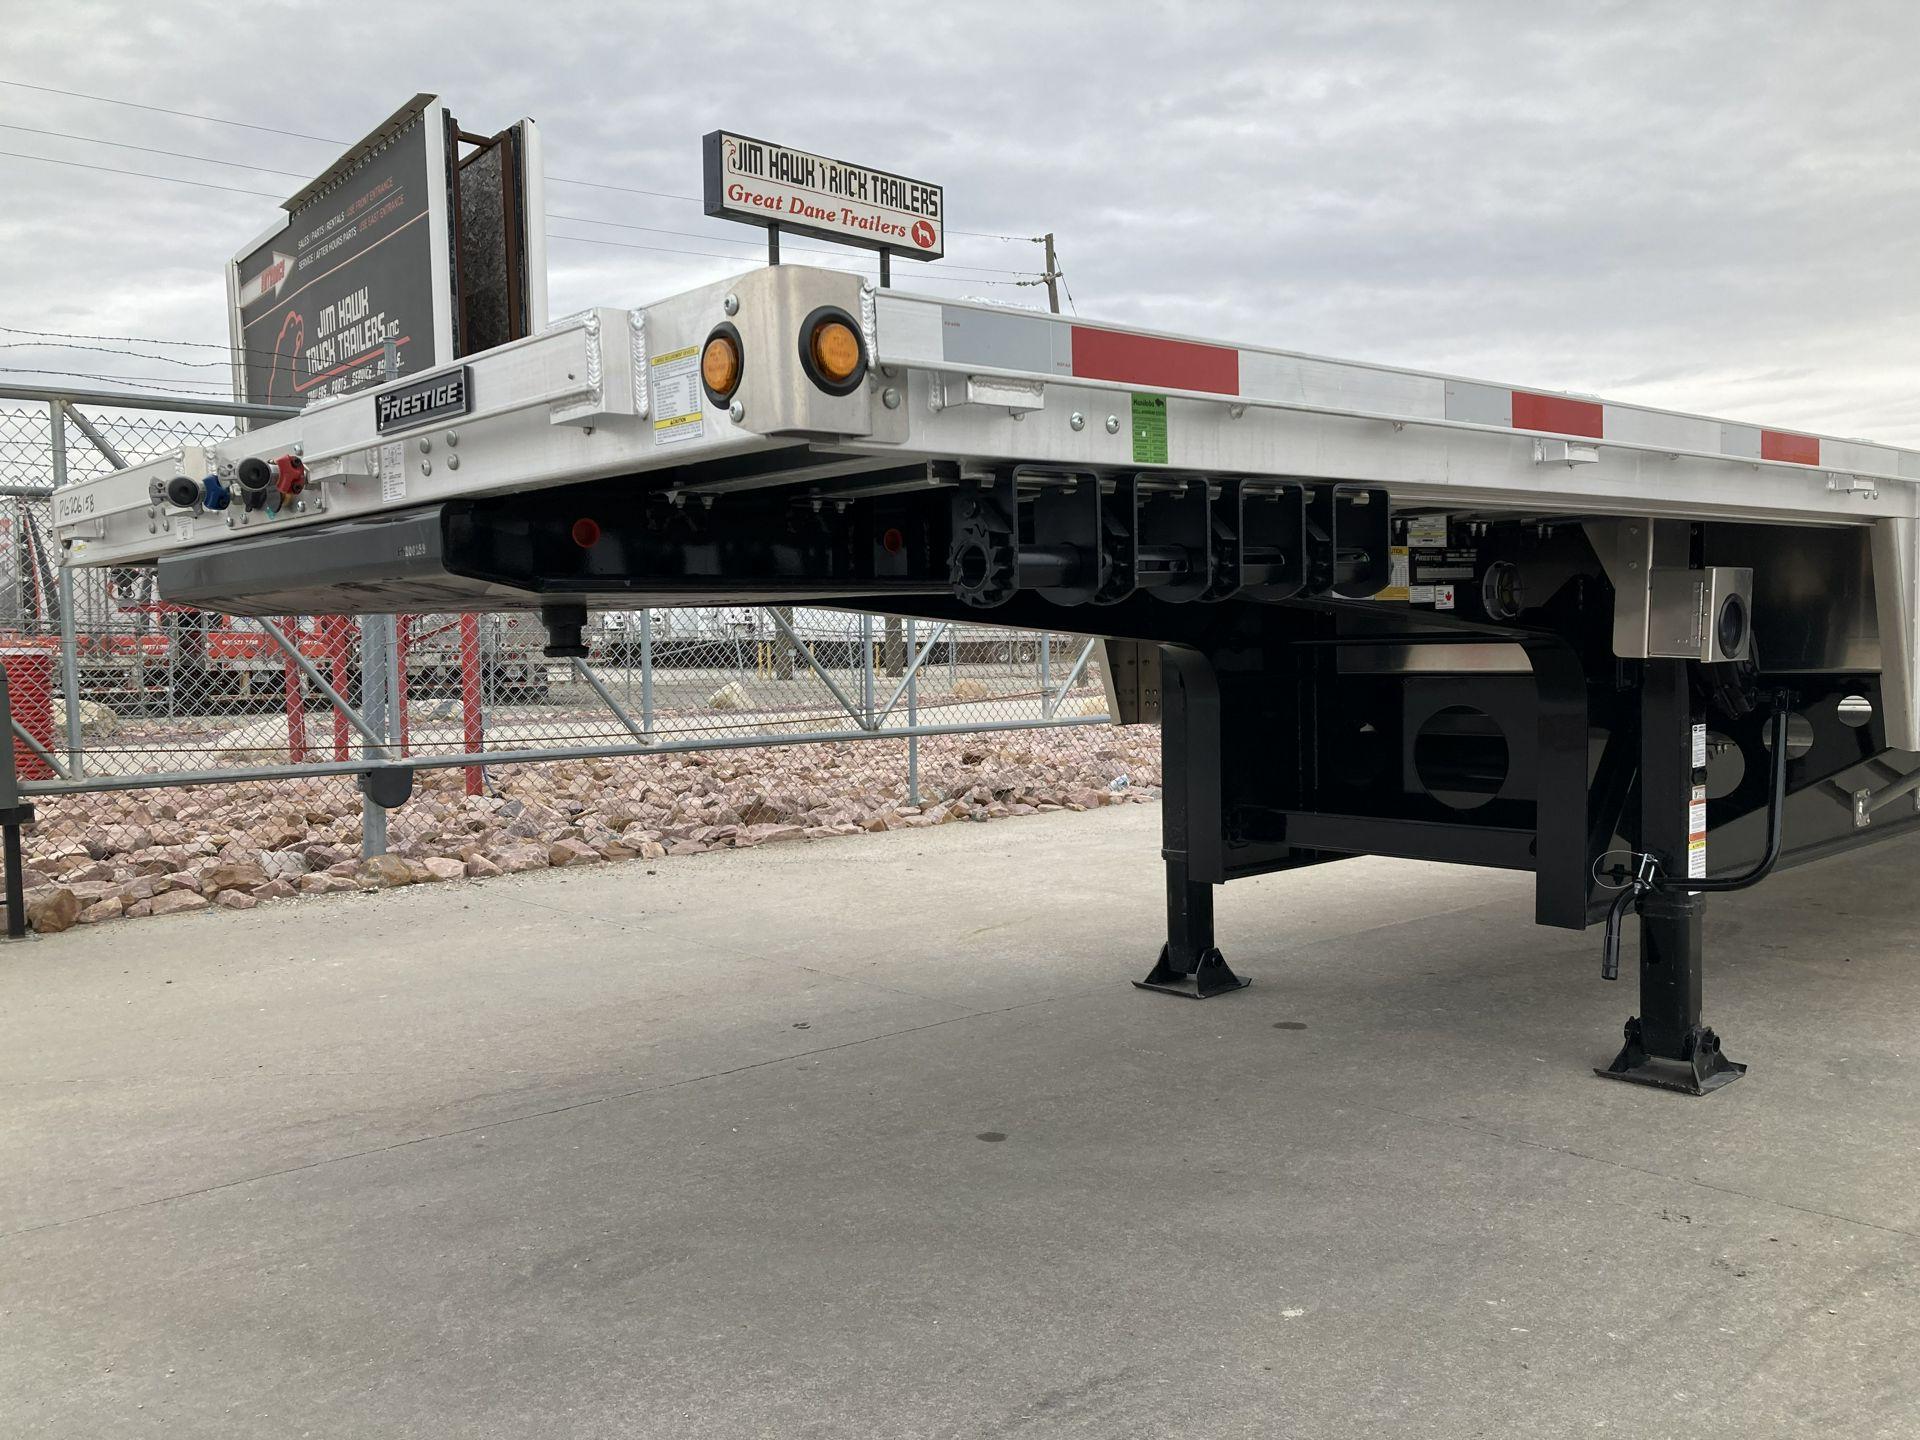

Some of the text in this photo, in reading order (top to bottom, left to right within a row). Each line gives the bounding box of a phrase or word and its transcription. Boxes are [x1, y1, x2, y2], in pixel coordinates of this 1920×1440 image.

[727, 183, 906, 238] Great Dane Trailers
[732, 141, 763, 176] JIM
[769, 148, 815, 188] HAWK
[871, 175, 938, 217] TRAILERS
[298, 234, 310, 250] SALES
[311, 225, 324, 239] PARTS
[326, 210, 345, 230] RENTALS
[369, 176, 393, 202] ENTRANCE
[298, 253, 314, 271] SERVICE
[315, 243, 330, 260] AFTER
[329, 234, 343, 251] HOURS
[343, 226, 357, 241] PARTS
[380, 193, 405, 219] ENTRANCE
[305, 337, 336, 376] TRUCK
[337, 311, 385, 361] TRAILERS
[317, 286, 369, 339] JIM HAWK
[380, 382, 458, 422] PRESTIGE
